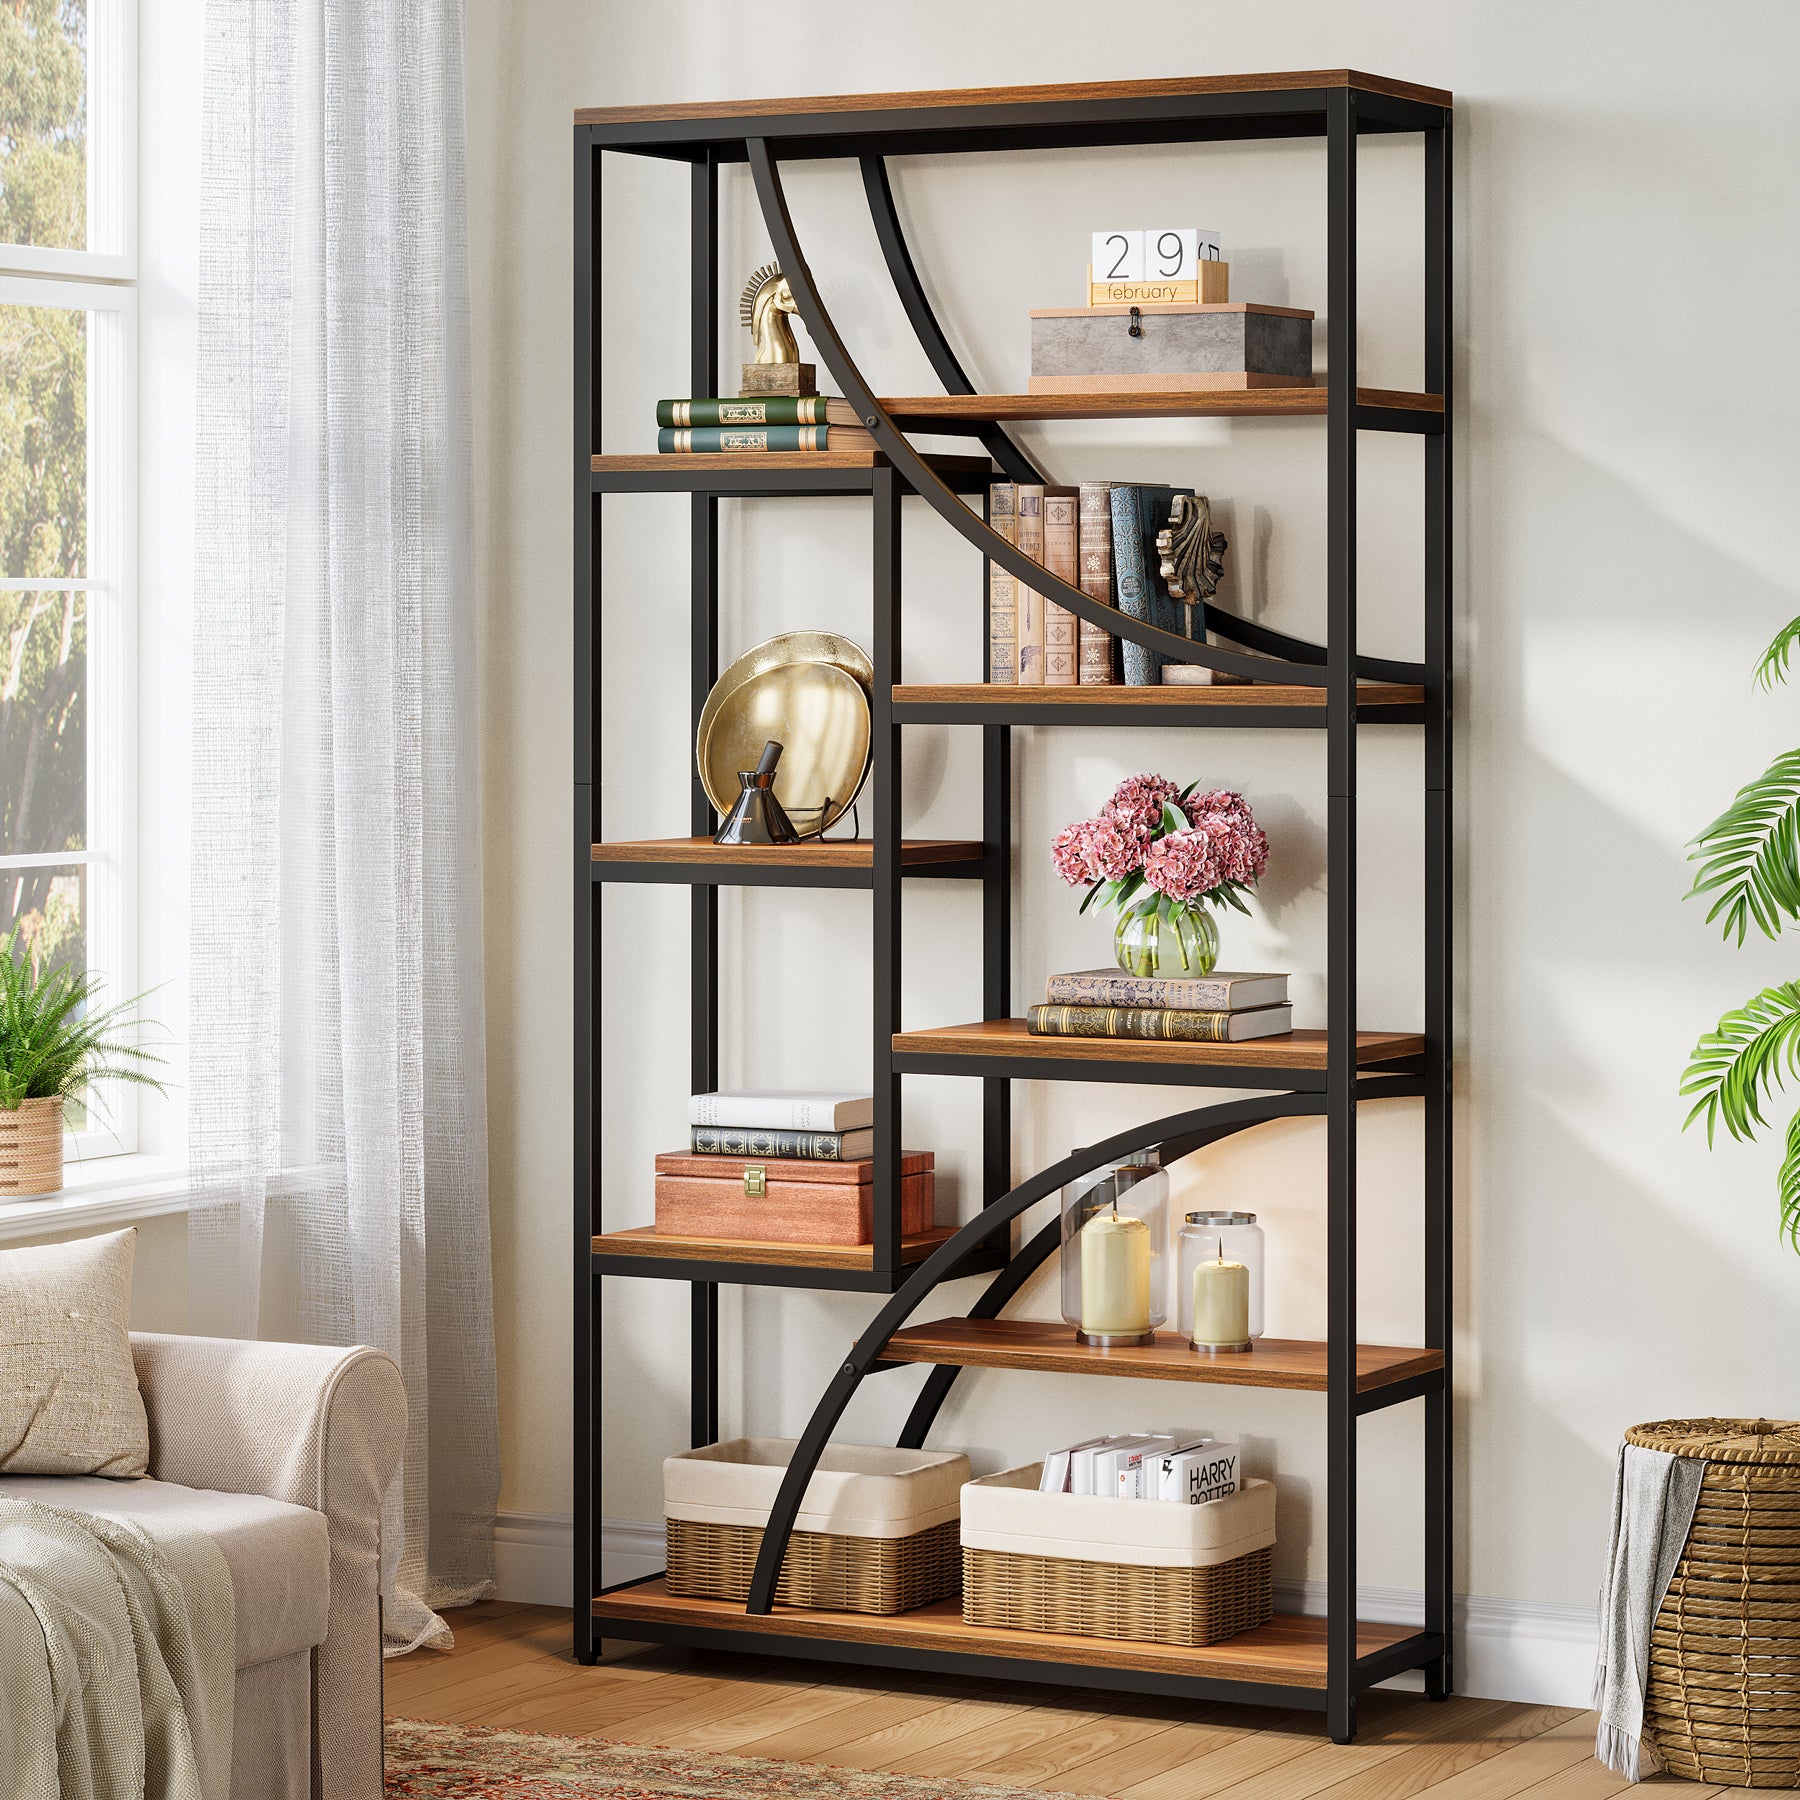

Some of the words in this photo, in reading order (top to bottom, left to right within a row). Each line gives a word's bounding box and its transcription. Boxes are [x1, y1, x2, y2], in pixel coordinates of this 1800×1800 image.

[1105, 234, 1130, 279] 2
[1157, 232, 1183, 277] 9
[1107, 283, 1178, 302] february
[1190, 1455, 1236, 1492] HARRY
